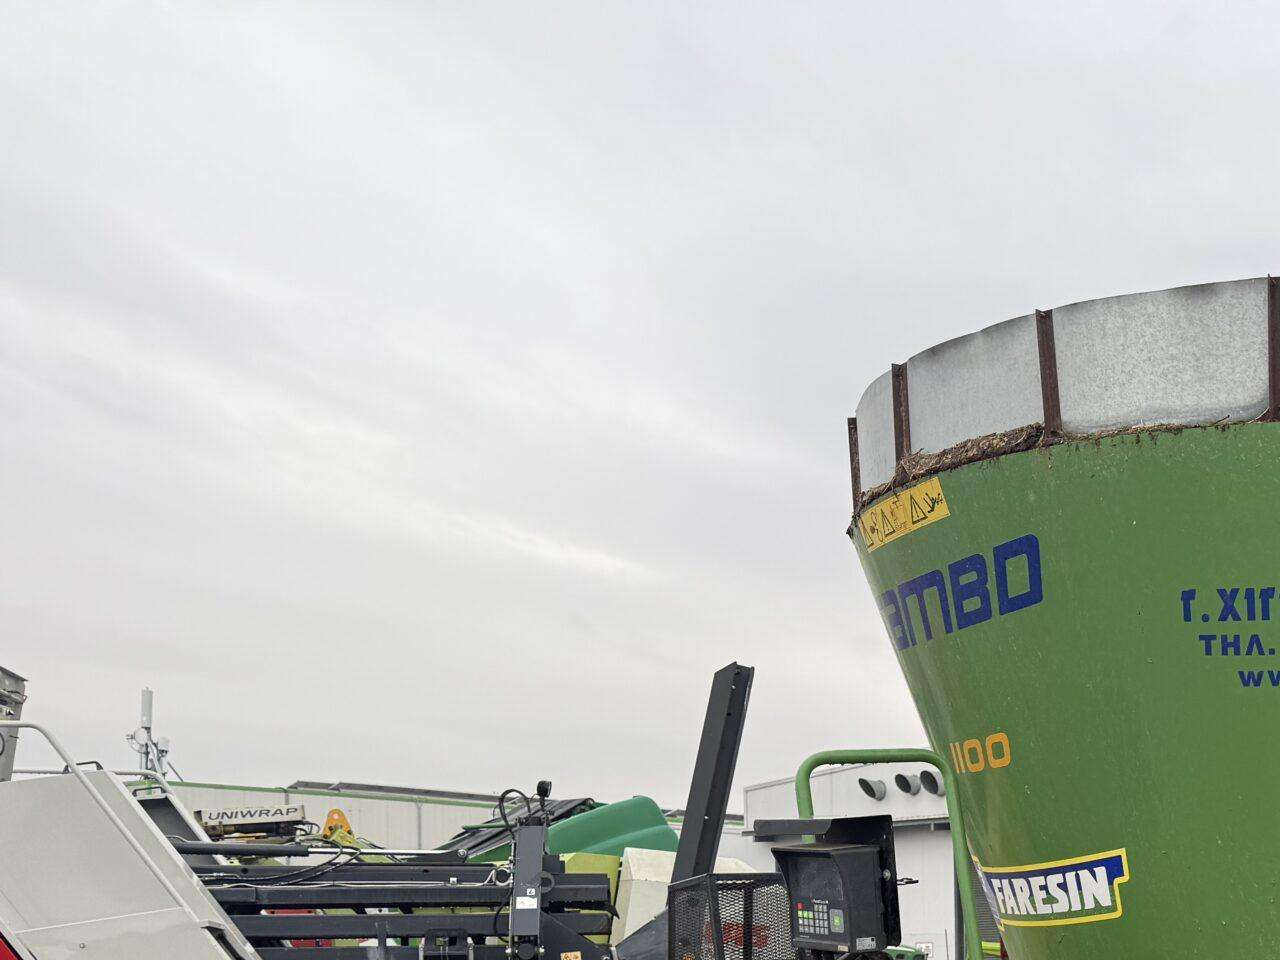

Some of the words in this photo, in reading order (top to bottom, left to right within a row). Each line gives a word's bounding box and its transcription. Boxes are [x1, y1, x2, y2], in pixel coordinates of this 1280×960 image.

[1199, 633, 1275, 657] ΤΗΛ.
[208, 807, 298, 821] UNIWRAP
[991, 866, 1112, 915] FARESIN
